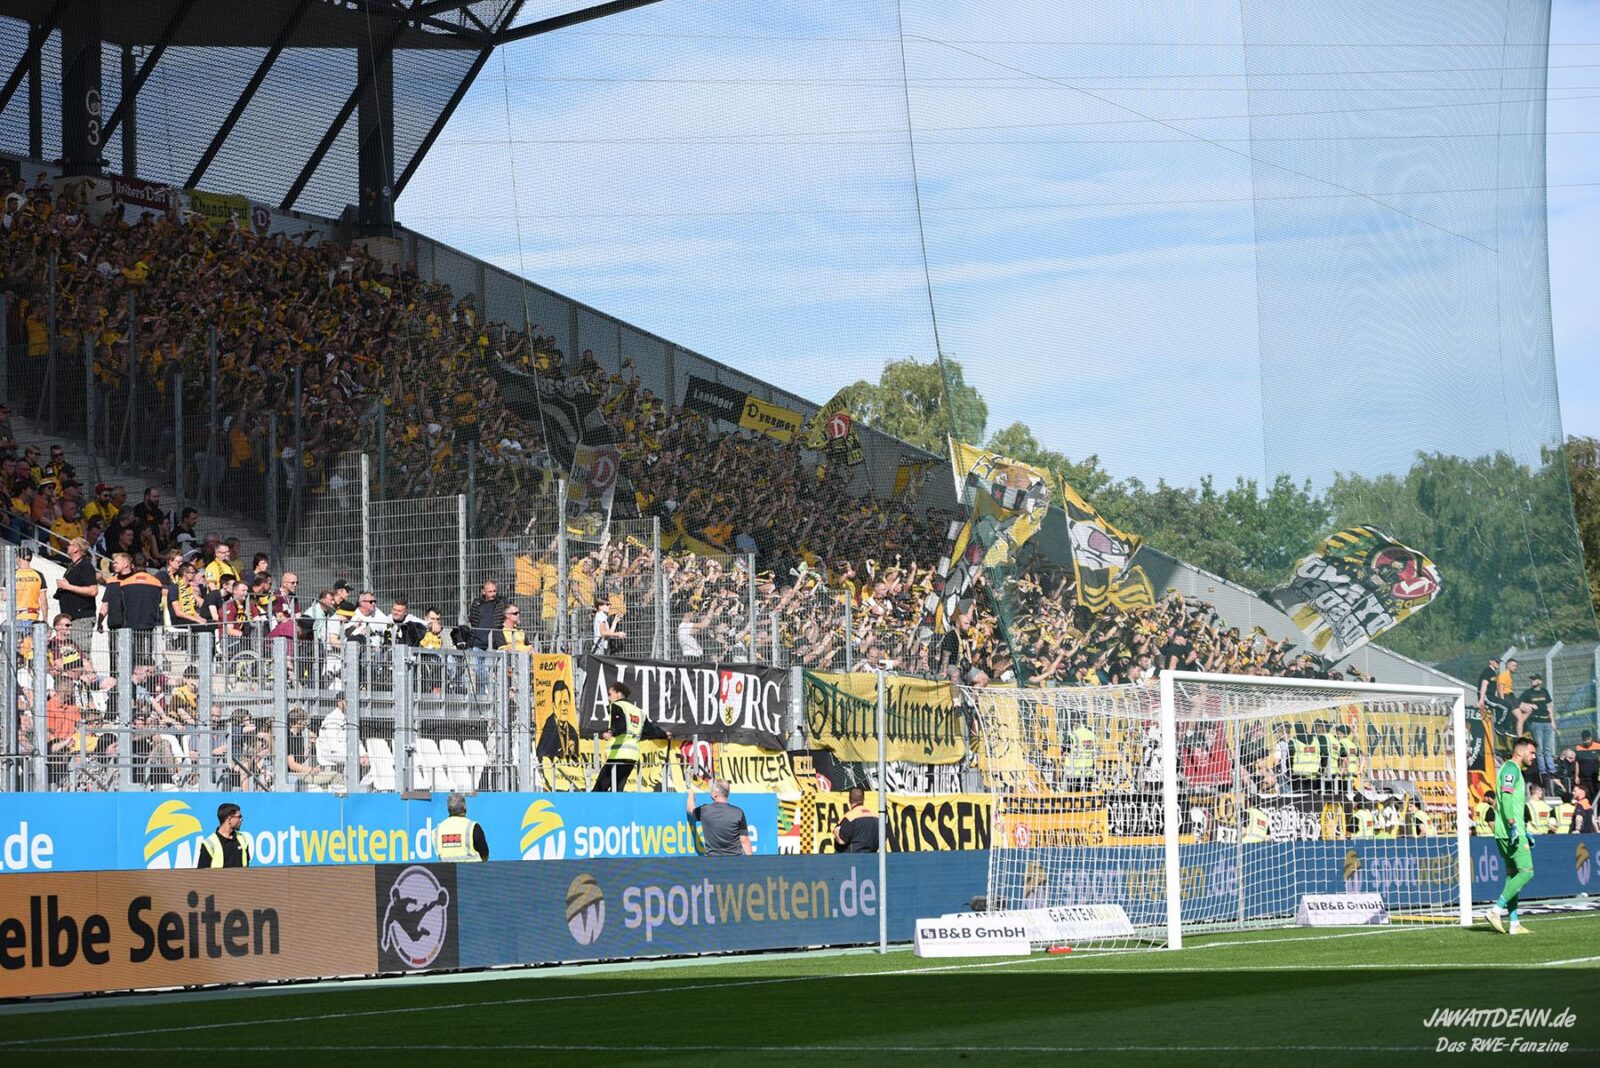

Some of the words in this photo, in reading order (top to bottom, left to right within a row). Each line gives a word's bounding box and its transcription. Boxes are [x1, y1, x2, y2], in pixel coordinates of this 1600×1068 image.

[87, 119, 99, 146] 3
[539, 661, 558, 672] #ROY
[1370, 853, 1499, 894] sportwette.de
[623, 866, 876, 942] sportwetten.de
[1347, 901, 1384, 911] GmbH
[127, 890, 280, 962] Seiten
[938, 928, 972, 940] B&B
[975, 926, 1027, 939] GmbH
